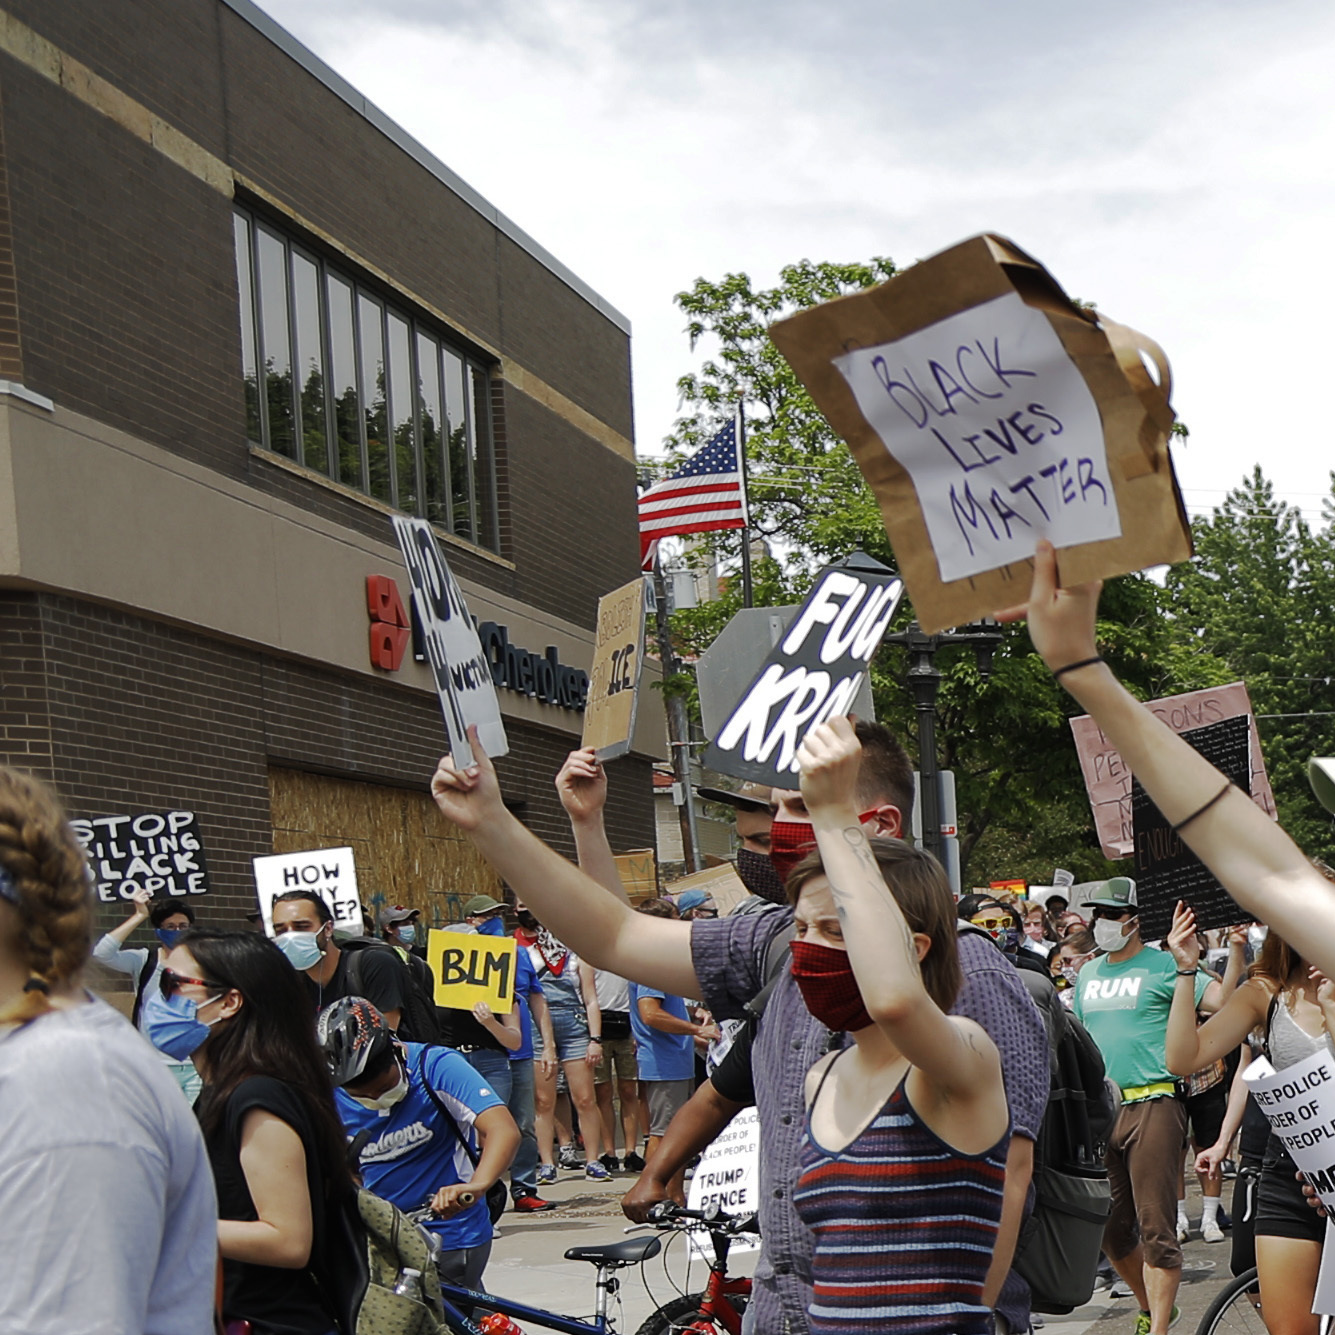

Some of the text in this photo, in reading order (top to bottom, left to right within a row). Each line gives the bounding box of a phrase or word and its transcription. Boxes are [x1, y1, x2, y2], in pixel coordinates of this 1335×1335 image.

[870, 337, 1037, 429] BLACK
[931, 402, 1064, 472] LIVES
[949, 457, 1108, 557] MATTER
[68, 811, 195, 843] STOP
[98, 872, 207, 903] EOPLE
[283, 863, 339, 887] HOW
[442, 948, 511, 999] BLM
[1083, 977, 1141, 1000] RUN
[1275, 1066, 1332, 1103] POLICE
[1298, 1100, 1320, 1122] OF
[739, 1130, 749, 1140] OF
